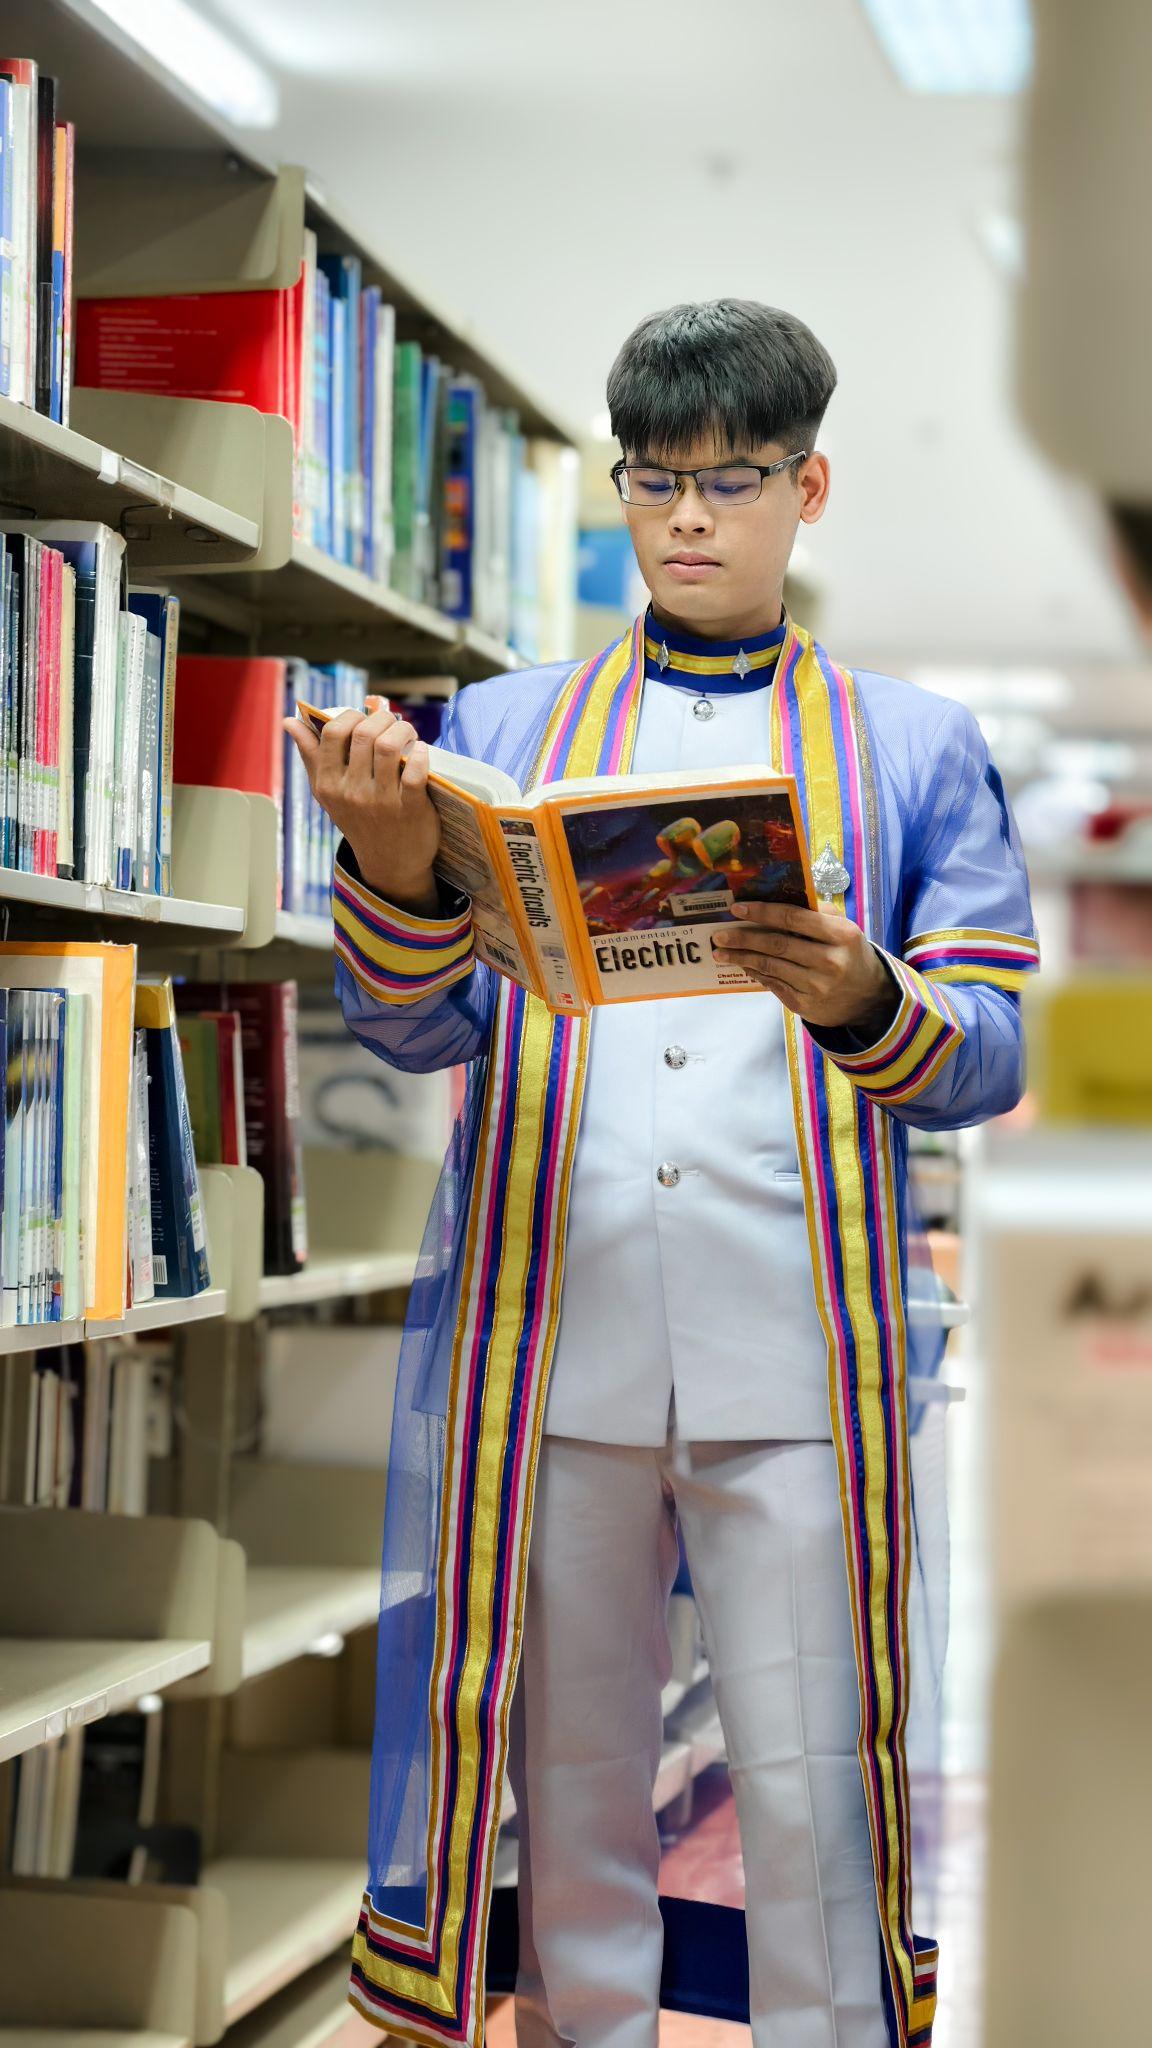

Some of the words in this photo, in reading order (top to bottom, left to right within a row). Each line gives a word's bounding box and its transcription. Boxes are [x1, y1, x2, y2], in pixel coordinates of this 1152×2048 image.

[507, 841, 540, 883] Electric
[520, 886, 552, 928] Circuits
[592, 929, 677, 945] Fundamentals
[682, 927, 694, 936] of
[595, 938, 702, 973] Electric
